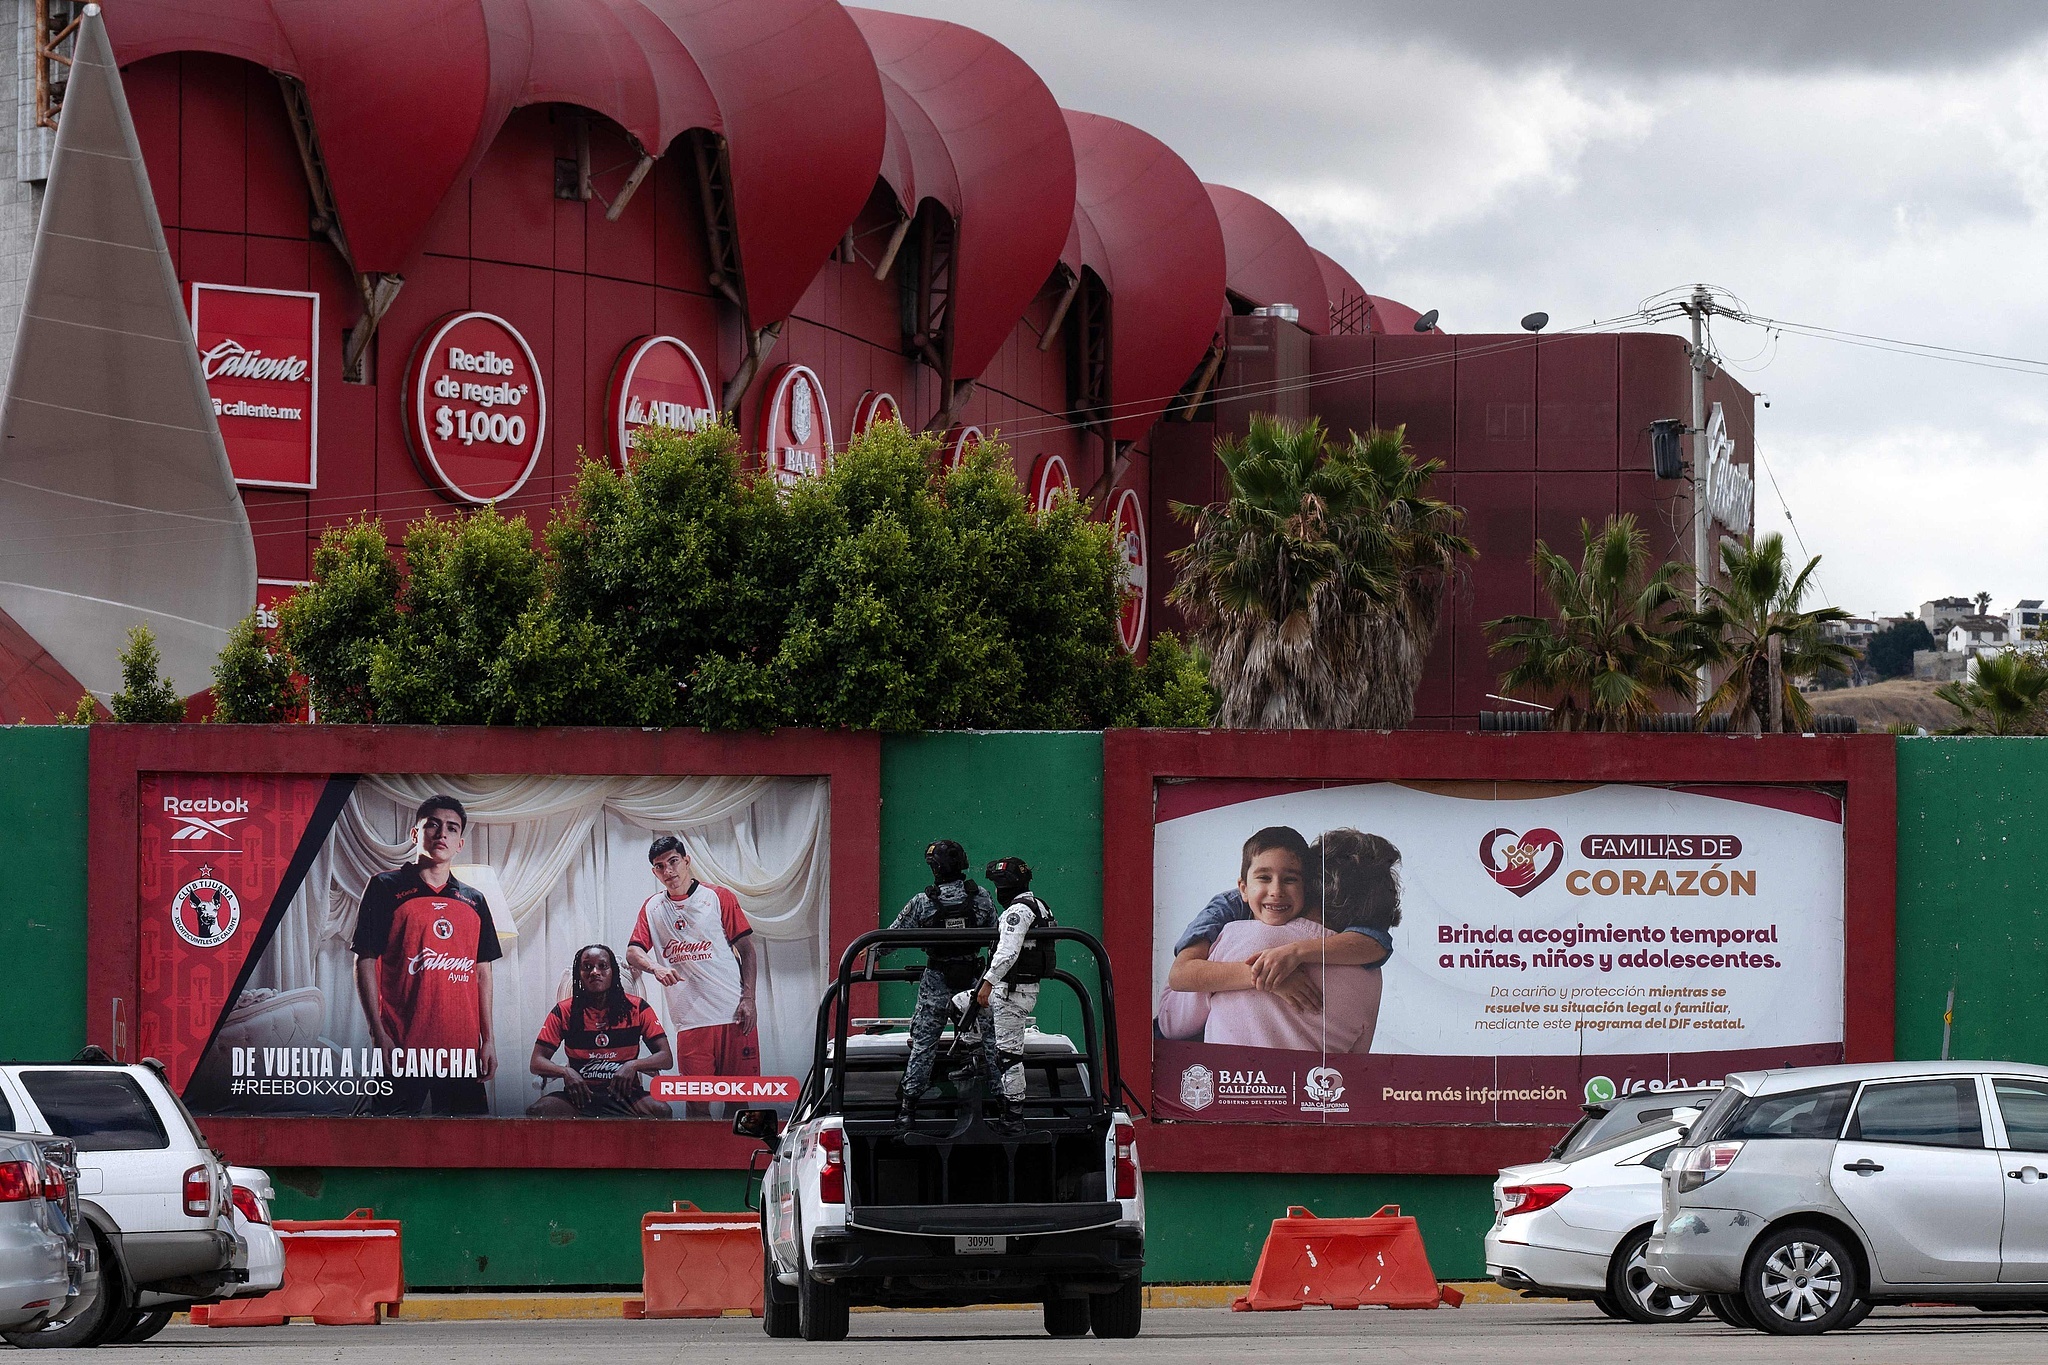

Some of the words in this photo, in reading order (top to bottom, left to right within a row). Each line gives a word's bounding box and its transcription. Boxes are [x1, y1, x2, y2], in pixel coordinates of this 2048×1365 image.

[200, 339, 307, 381] Caliente
[449, 347, 514, 376] Recibe
[434, 374, 460, 399] de
[222, 400, 302, 420] caliente.mx
[435, 405, 526, 446] $1,000
[163, 796, 249, 815] Reebok
[1591, 838, 1693, 856] FAMILIAS
[1701, 839, 1732, 856] DE
[1565, 863, 1757, 897] CORAZÓN
[178, 882, 198, 901] CLUB
[199, 881, 233, 901] TIJUANA
[1438, 923, 1513, 944] Brinda
[1518, 922, 1666, 948] acogimiento
[1670, 924, 1778, 948] temporal
[662, 939, 713, 959] Caliente
[408, 947, 475, 975] Caliente
[1438, 954, 1455, 968] a
[1459, 948, 1528, 972] niñas,
[1532, 947, 1595, 968] niños
[1599, 954, 1612, 972] y
[1617, 948, 1782, 969] adolescentes.
[1490, 986, 1509, 998] Da
[1512, 985, 1557, 998] cariño
[1560, 988, 1568, 999] y
[1571, 985, 1646, 999] protección
[1648, 985, 1709, 998] mientras
[1711, 988, 1727, 998] se
[1484, 1001, 1541, 1014] resuelve
[1543, 1004, 1559, 1013] su
[1561, 1000, 1624, 1014] situación
[1626, 1001, 1662, 1016] legal
[1664, 1004, 1672, 1014] o
[1673, 1001, 1731, 1016] familiar,
[1474, 1017, 1540, 1030] mediante
[1543, 1018, 1572, 1030] este
[1574, 1019, 1643, 1032] programa
[1644, 1017, 1667, 1029] del
[1668, 1018, 1691, 1030] DIF
[1693, 1017, 1746, 1030] estatal.
[232, 1047, 256, 1077] DE
[263, 1047, 334, 1078] VUELTA
[340, 1047, 354, 1077] A
[361, 1047, 384, 1078] LA
[391, 1047, 478, 1078] CANCHA
[230, 1079, 394, 1096] #REEBOKXOLOS
[1218, 1070, 1268, 1086] BAJA
[660, 1081, 789, 1096] REEBOK.MX
[1218, 1085, 1287, 1094] CALIFORNIA
[1382, 1087, 1423, 1101] Para
[1426, 1086, 1463, 1101] más
[1465, 1085, 1568, 1105] información
[967, 1236, 994, 1247] 30990
